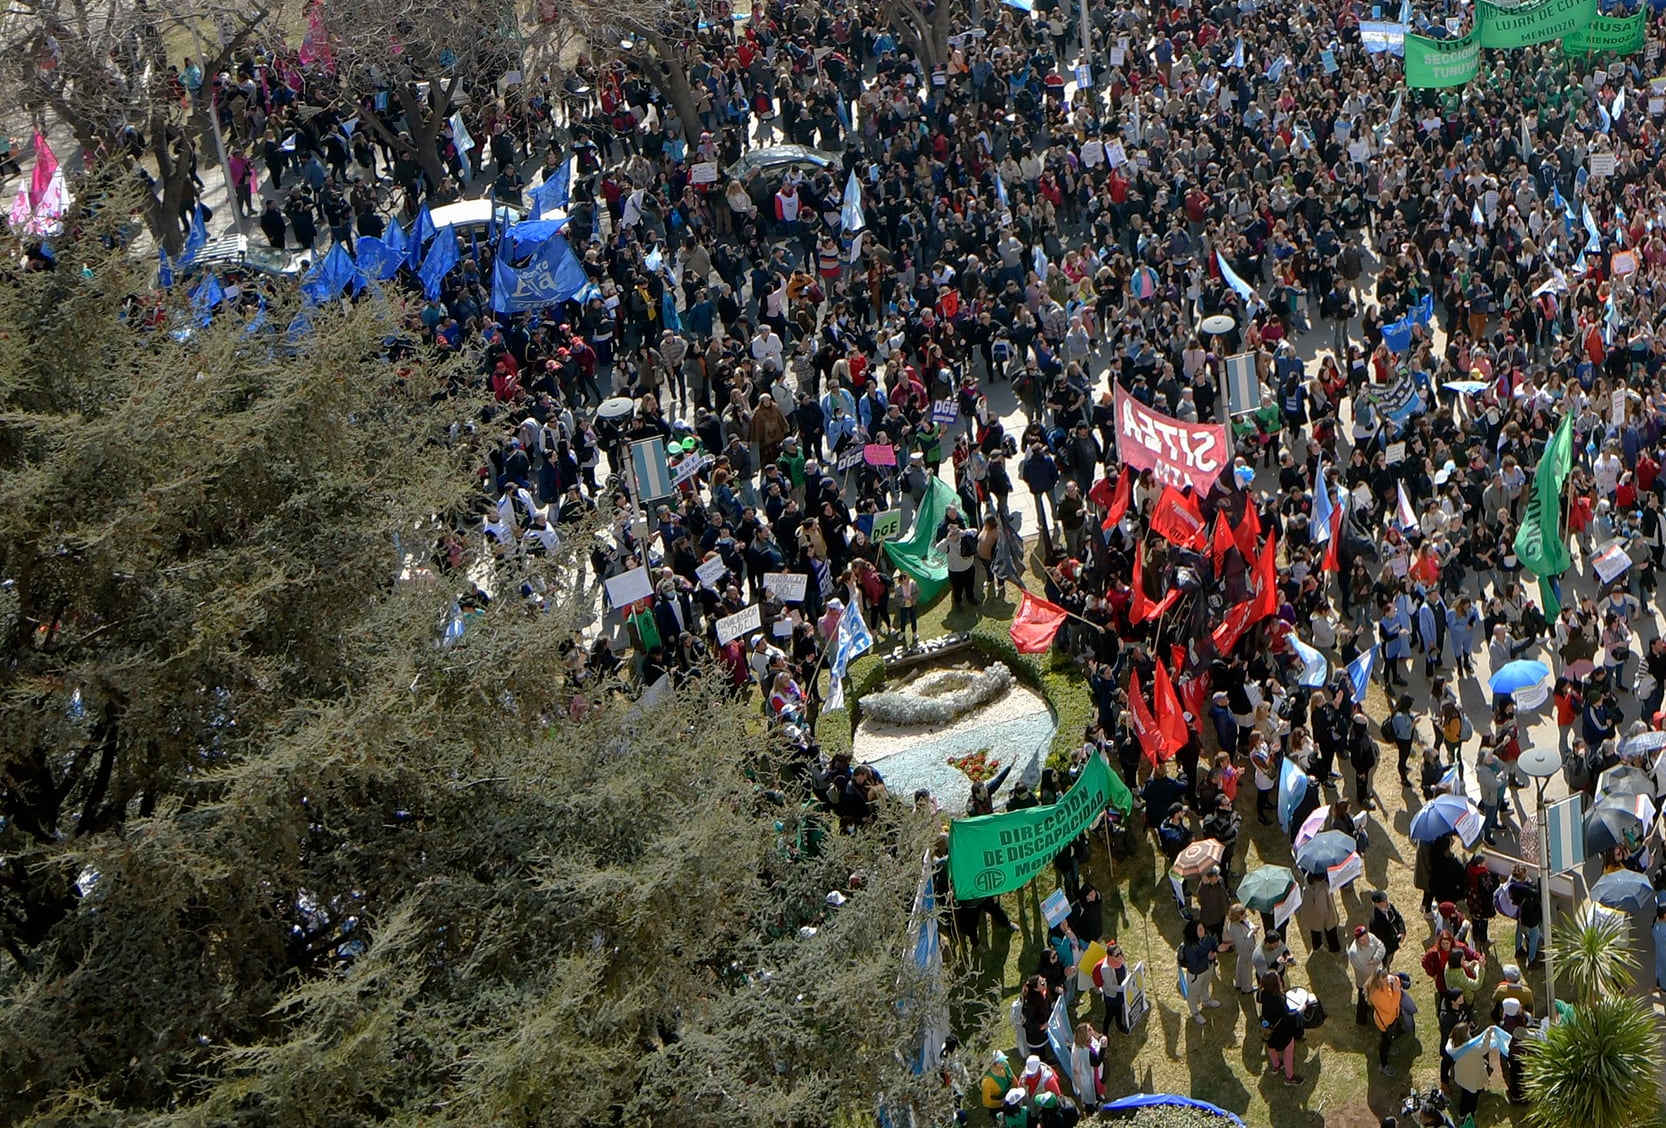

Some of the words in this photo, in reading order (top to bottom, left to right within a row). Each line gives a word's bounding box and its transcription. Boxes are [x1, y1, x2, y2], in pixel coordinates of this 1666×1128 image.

[1495, 14, 1536, 31] LUJAN
[1539, 9, 1554, 24] DE
[1520, 19, 1576, 42] MENDOZA
[933, 400, 959, 416] DGE
[837, 451, 863, 471] DGE
[873, 520, 898, 541] DGE
[1168, 526, 1186, 541] UTEP
[983, 850, 1004, 868] DE
[1006, 790, 1104, 863] DISCAPACIDAD
